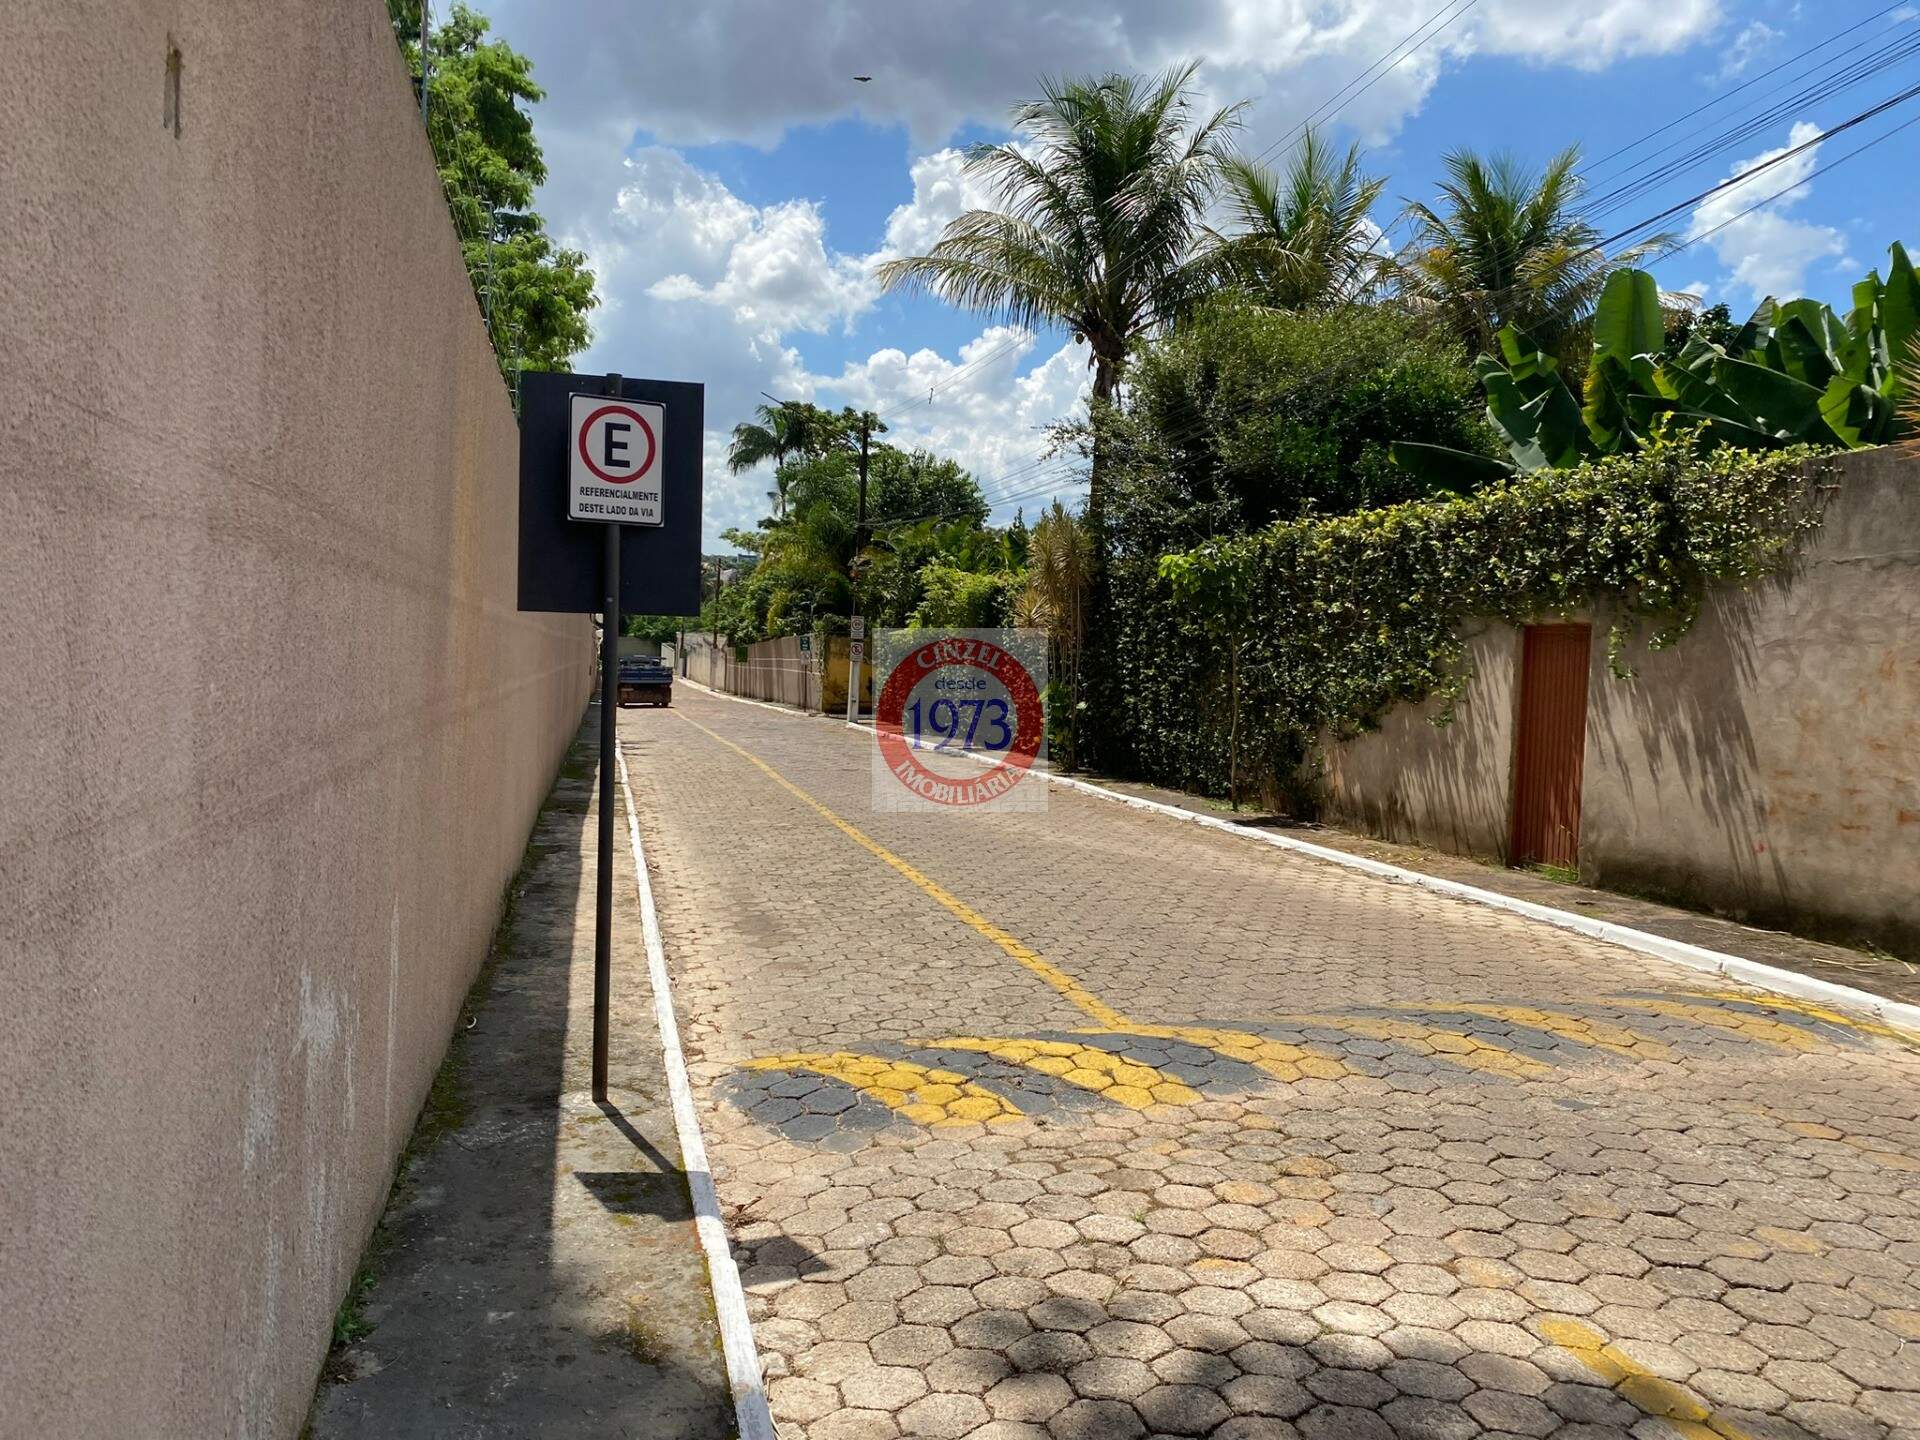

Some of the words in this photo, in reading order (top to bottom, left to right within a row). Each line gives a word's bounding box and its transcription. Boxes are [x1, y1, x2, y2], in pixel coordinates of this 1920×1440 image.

[604, 422, 631, 468] E
[579, 487, 659, 502] REFERENCIALMENTE
[579, 503, 604, 513] DESTE
[606, 505, 627, 515] LADO
[629, 507, 639, 516] DA
[641, 508, 654, 517] VIA
